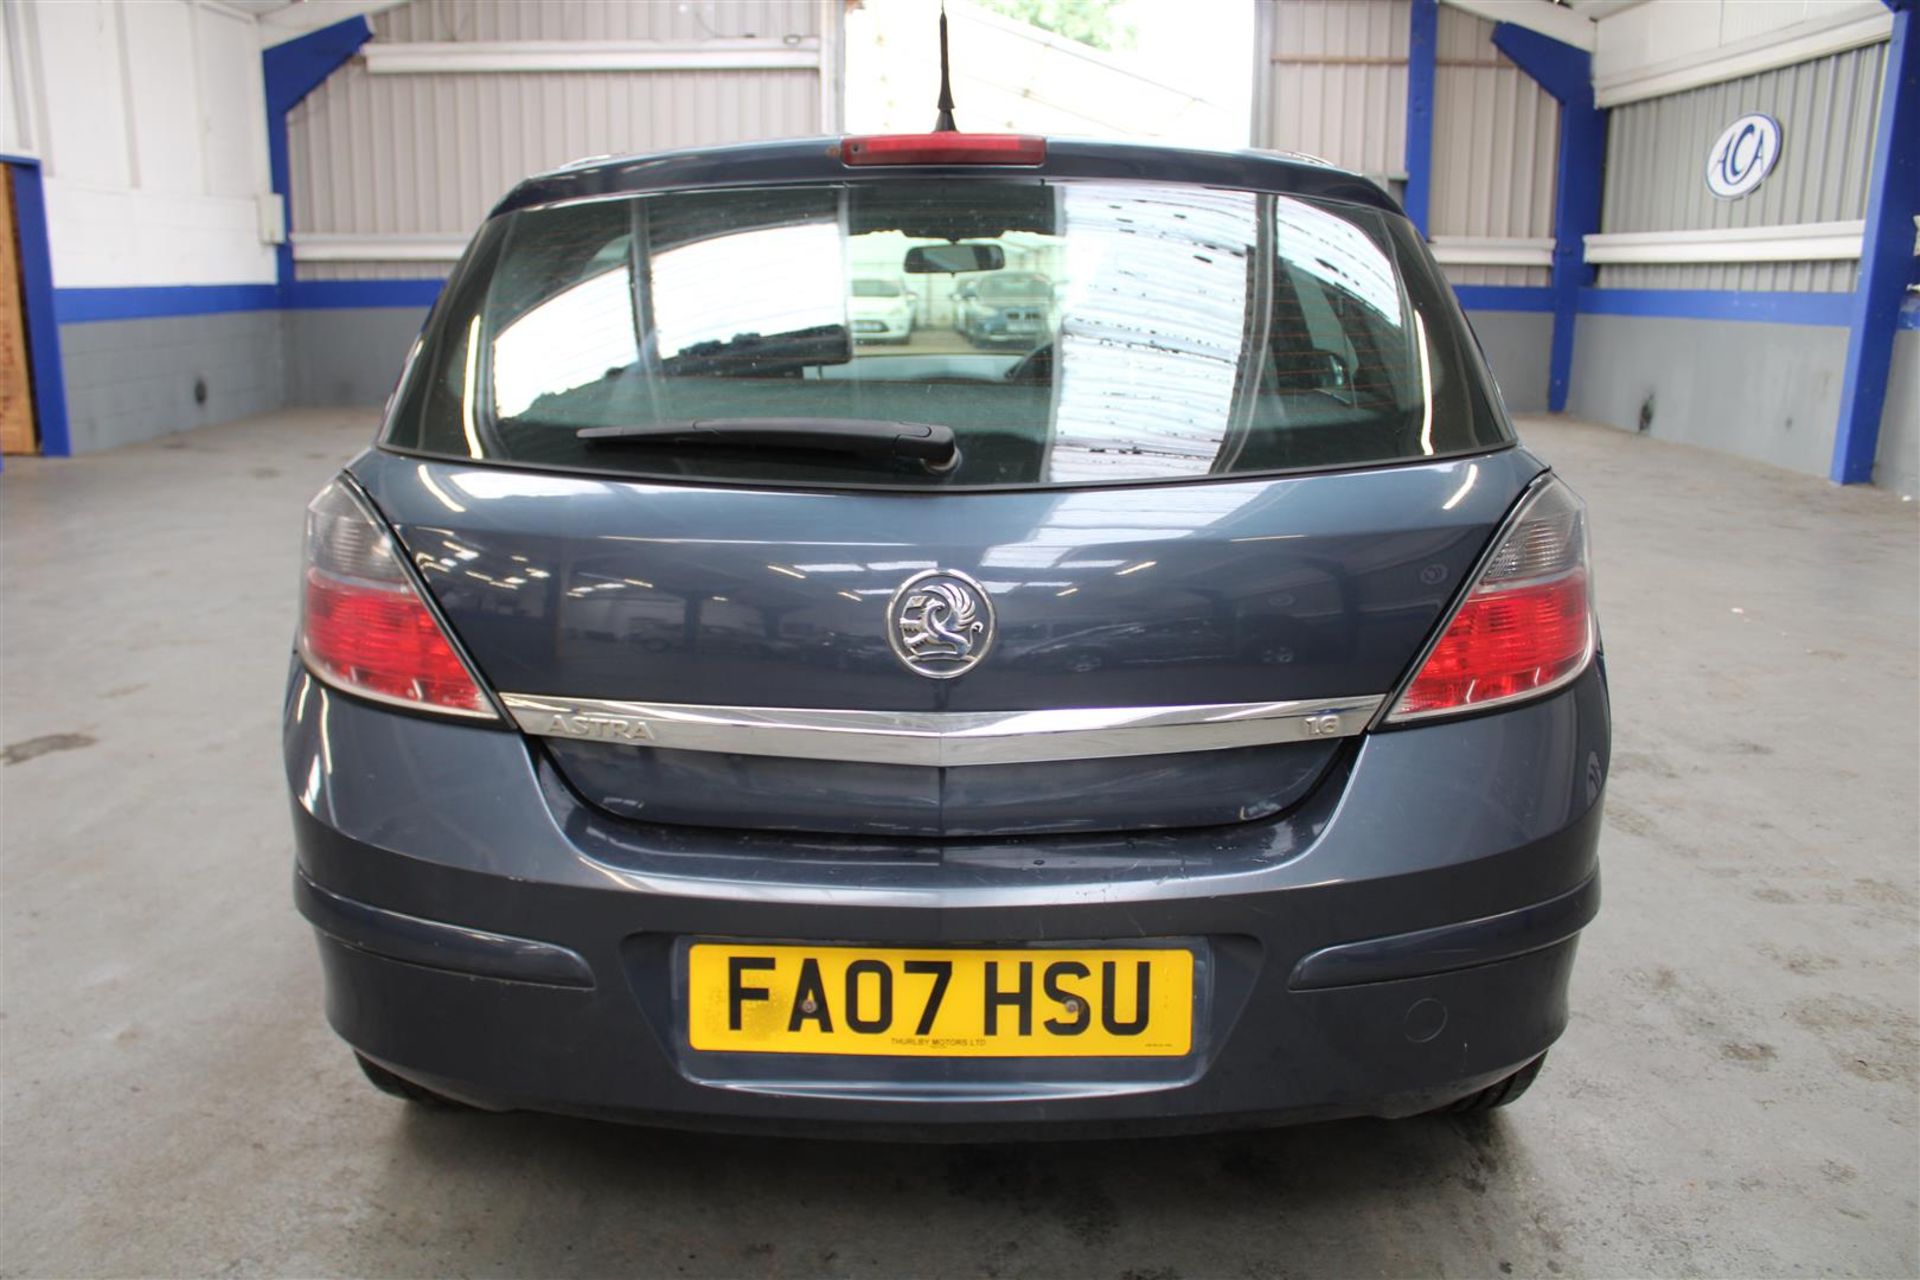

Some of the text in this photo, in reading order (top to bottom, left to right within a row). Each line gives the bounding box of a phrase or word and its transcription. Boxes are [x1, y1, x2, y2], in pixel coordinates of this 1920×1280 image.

[550, 714, 655, 741] ASTRA
[1305, 715, 1338, 736] 1.6
[728, 956, 1151, 1037] FA07 HSU
[931, 1038, 968, 1047] MOTORS
[970, 1039, 986, 1047] LTD
